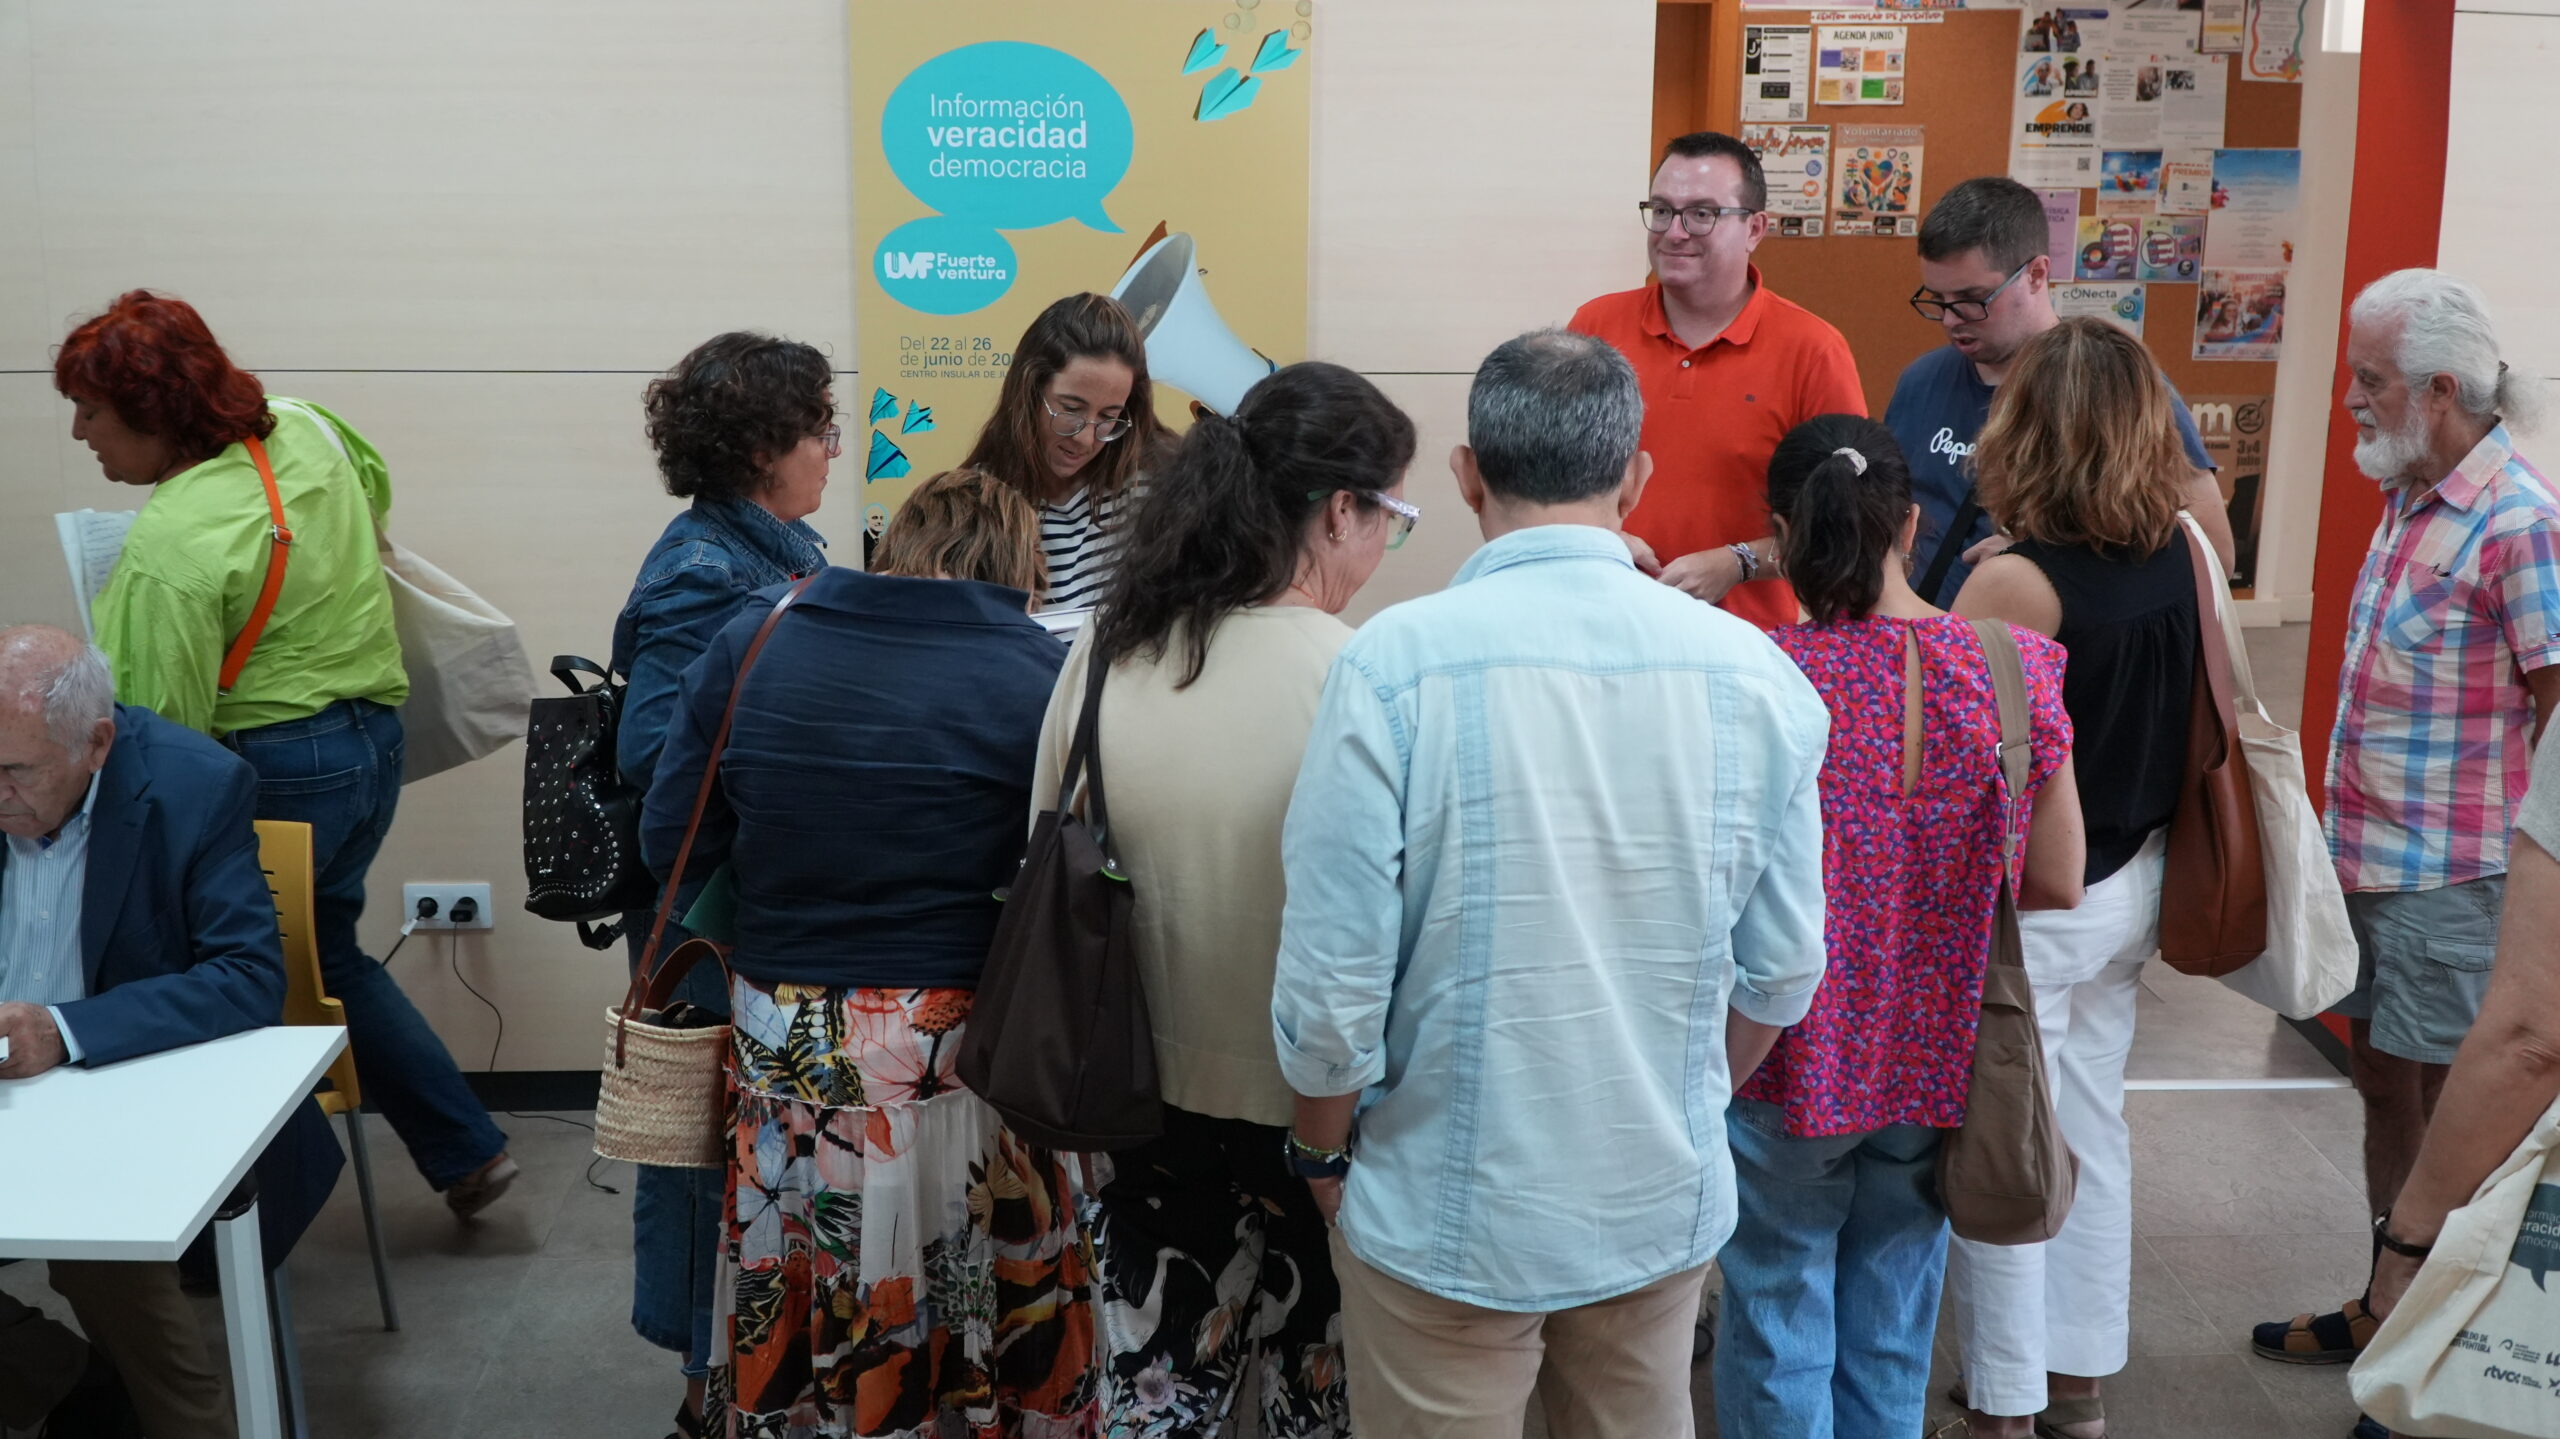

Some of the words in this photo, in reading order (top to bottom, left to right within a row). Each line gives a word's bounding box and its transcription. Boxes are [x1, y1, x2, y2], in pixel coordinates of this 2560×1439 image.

[1833, 31, 1866, 40] AGENDA
[1870, 31, 1893, 41] JUNIO
[930, 93, 1084, 119] Información
[927, 120, 1087, 149] veracidad
[1844, 126, 1918, 136] Voluntariado
[2025, 123, 2093, 133] EMPRENDE
[929, 152, 1087, 178] democracia
[937, 252, 996, 268] Fuerte
[937, 264, 1006, 280] ventura
[900, 336, 925, 351] Del
[930, 337, 950, 351] 22
[954, 336, 967, 351] al
[972, 337, 992, 351] 26
[900, 352, 919, 366] de
[923, 352, 963, 368] junio
[968, 352, 987, 366] de
[991, 352, 1014, 366] 20
[900, 370, 938, 378] CENTRO
[941, 370, 980, 378] INSULAR
[983, 370, 998, 378] DE
[1930, 427, 1977, 465] Pepe
[2236, 439, 2246, 454] 3
[2519, 1234, 2560, 1252] mocra
